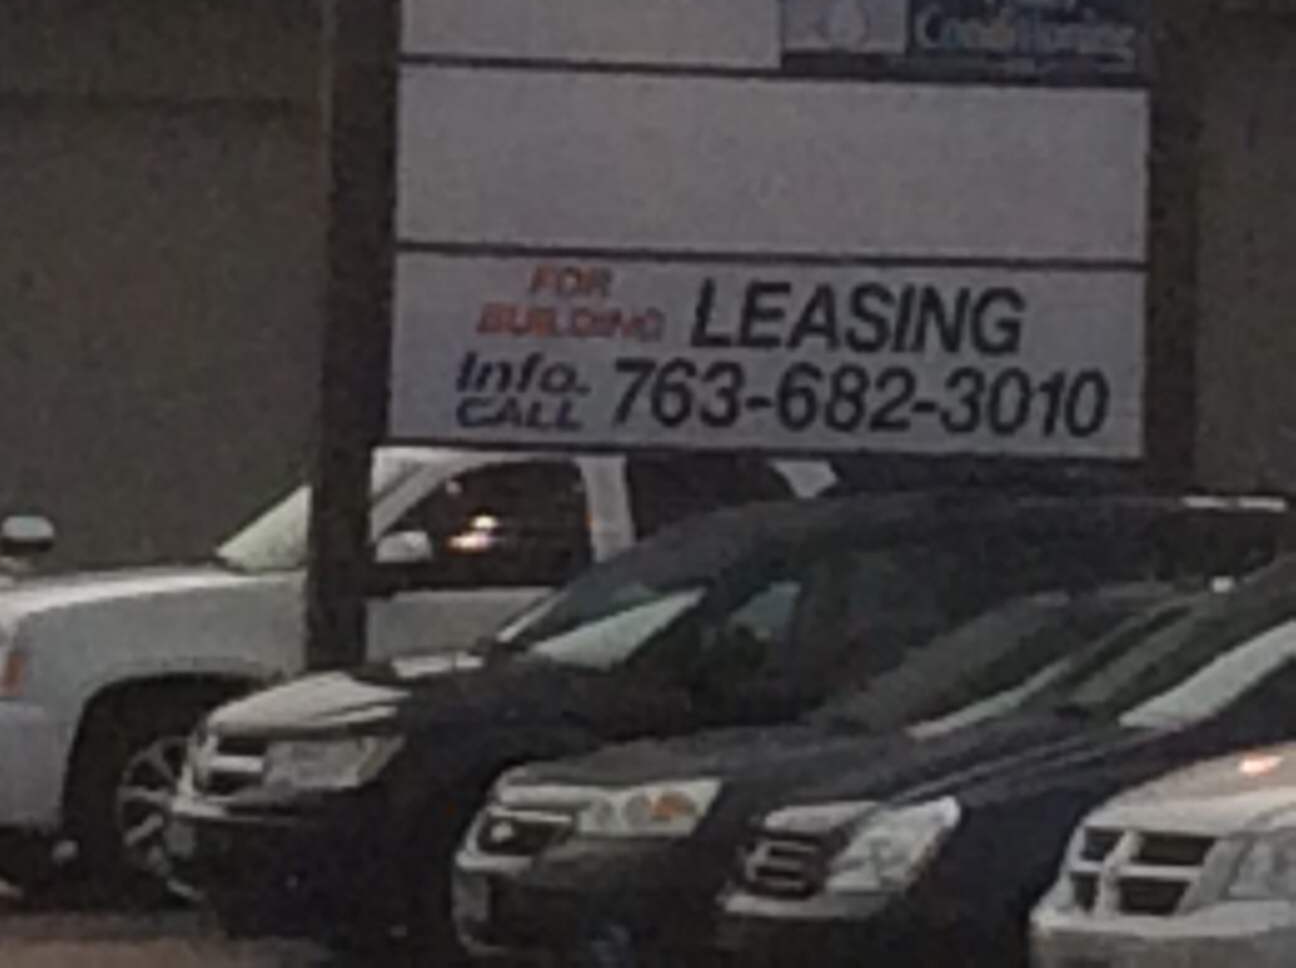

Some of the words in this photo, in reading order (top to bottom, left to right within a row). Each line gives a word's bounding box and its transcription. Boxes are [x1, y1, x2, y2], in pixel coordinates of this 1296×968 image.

[527, 264, 613, 297] FOR
[475, 302, 666, 342] BUILDING
[690, 277, 1026, 355] LEASING
[455, 350, 591, 395] Info.
[455, 395, 583, 433] CALL
[612, 355, 1110, 437] 763-682-3010
